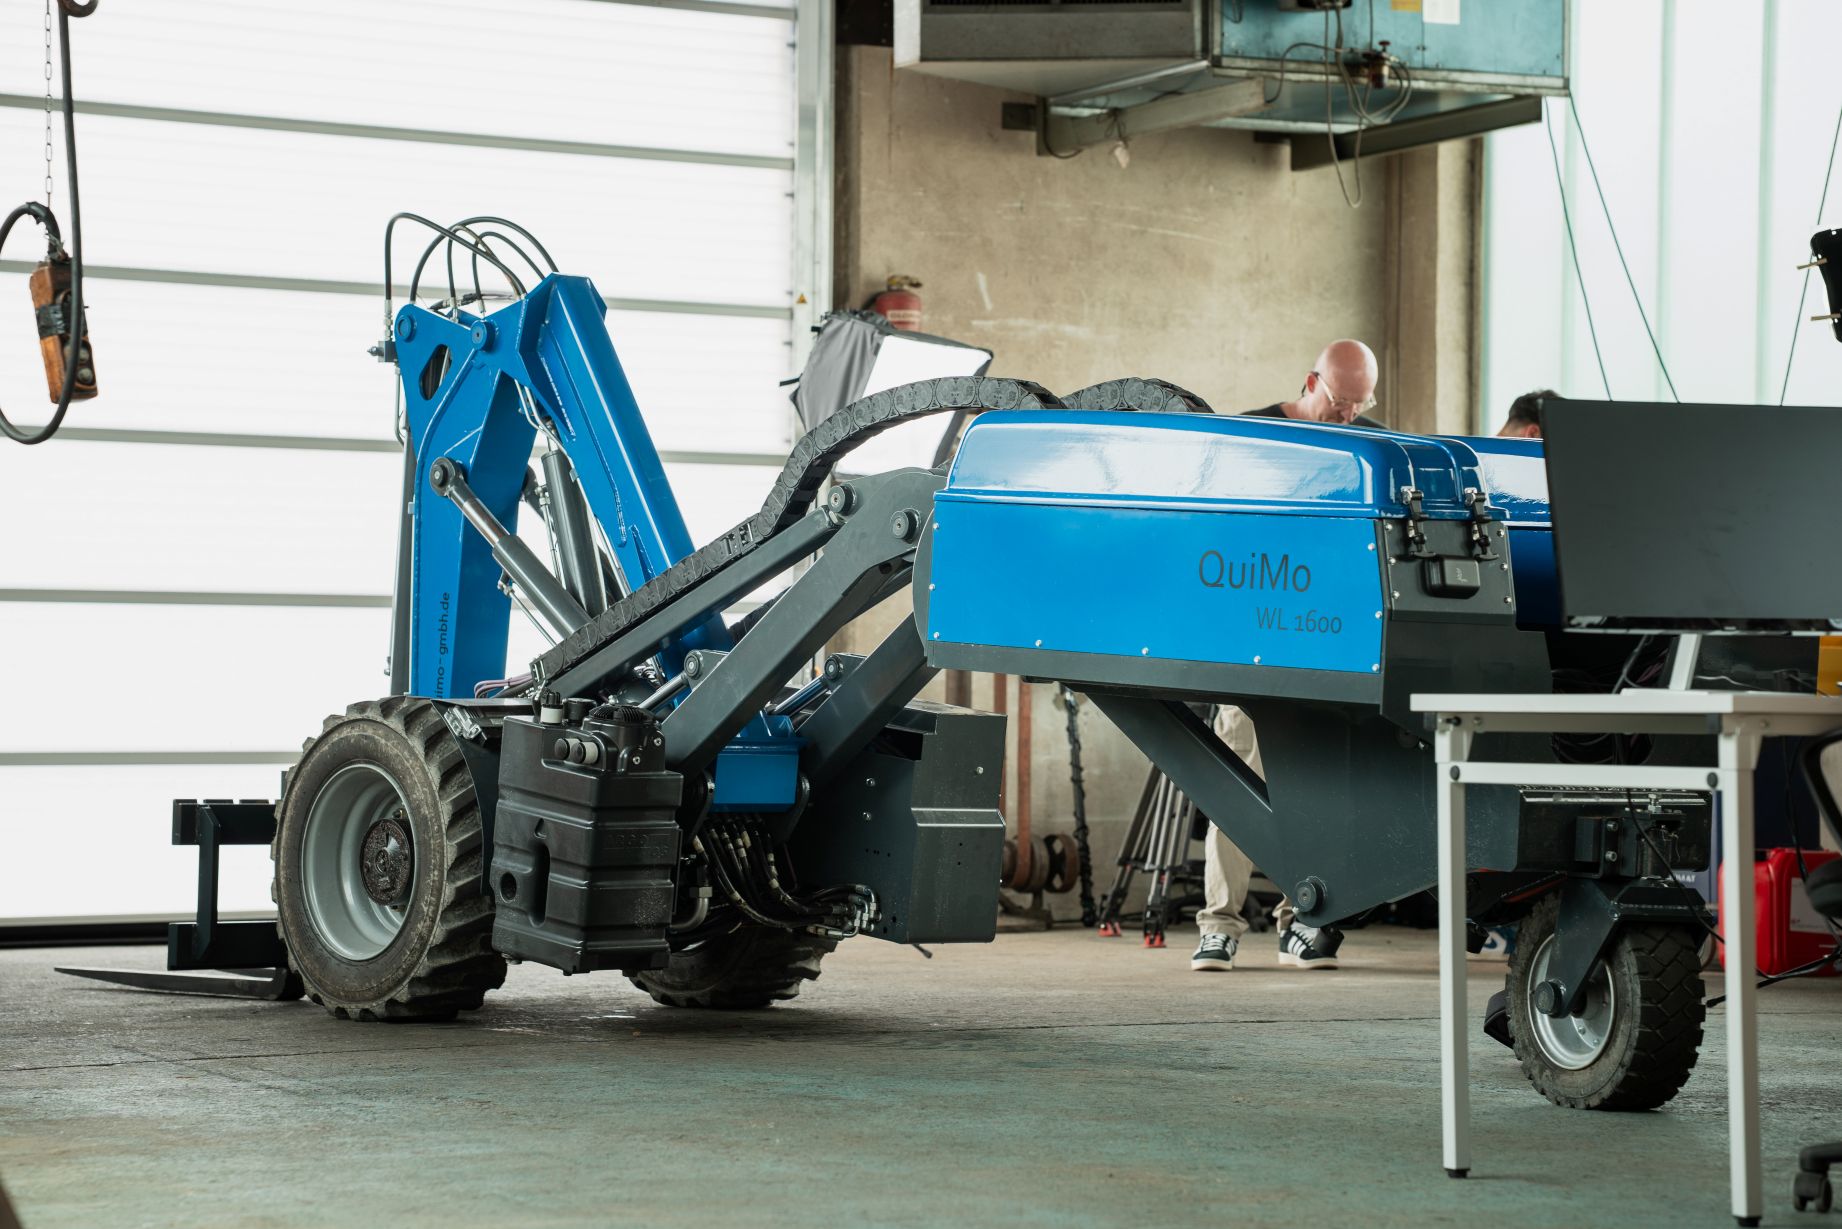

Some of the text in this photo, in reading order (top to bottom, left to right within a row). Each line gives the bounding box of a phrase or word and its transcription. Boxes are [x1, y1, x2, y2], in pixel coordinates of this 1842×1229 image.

[1199, 550, 1311, 592] QuiMo
[1256, 607, 1342, 634] WL 1600
